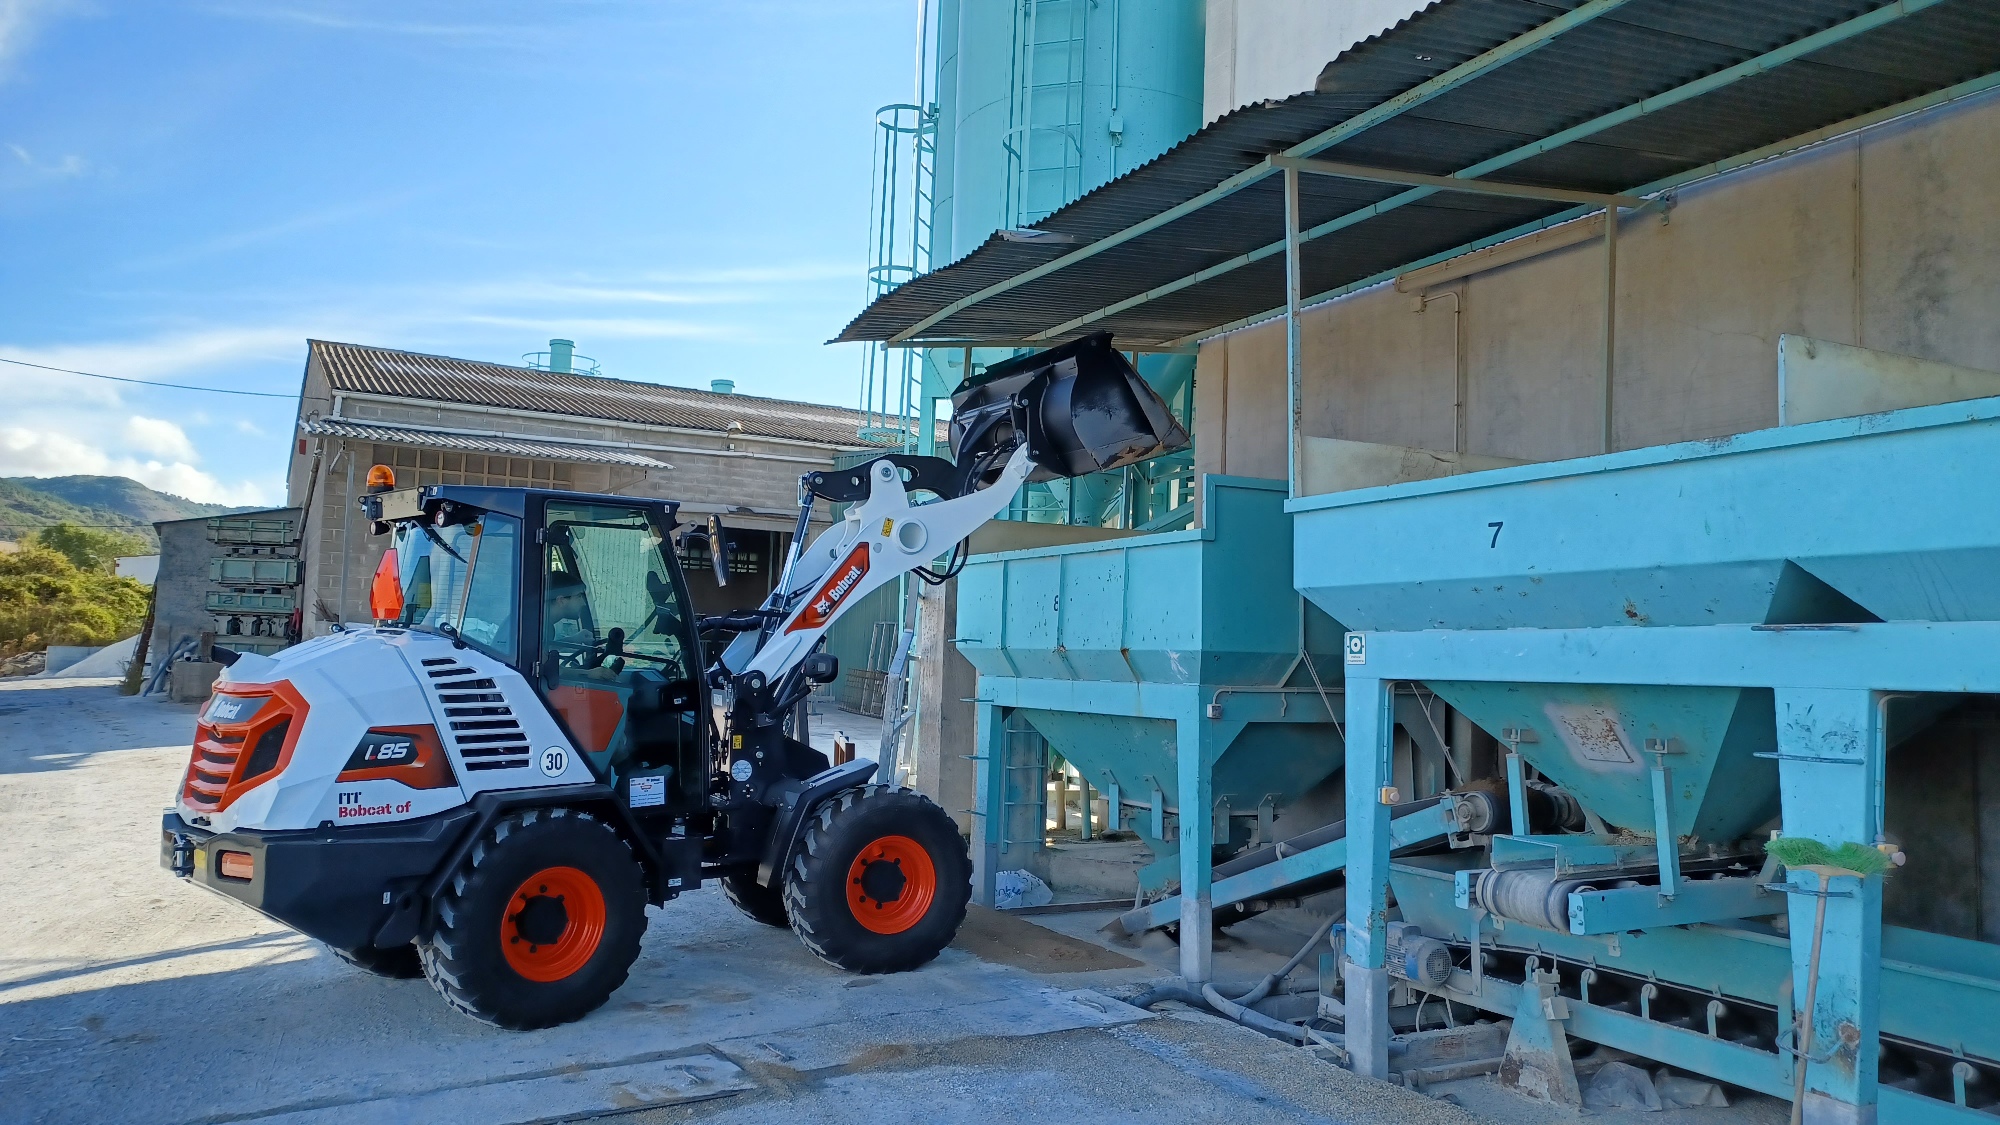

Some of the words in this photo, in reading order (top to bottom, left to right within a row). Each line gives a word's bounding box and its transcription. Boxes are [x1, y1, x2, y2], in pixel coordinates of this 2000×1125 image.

[1488, 521, 1504, 549] 7
[828, 565, 863, 601] Bobcat
[364, 742, 410, 761] L85
[546, 752, 563, 771] 30
[338, 804, 392, 818] Bobcat
[395, 800, 411, 814] of
